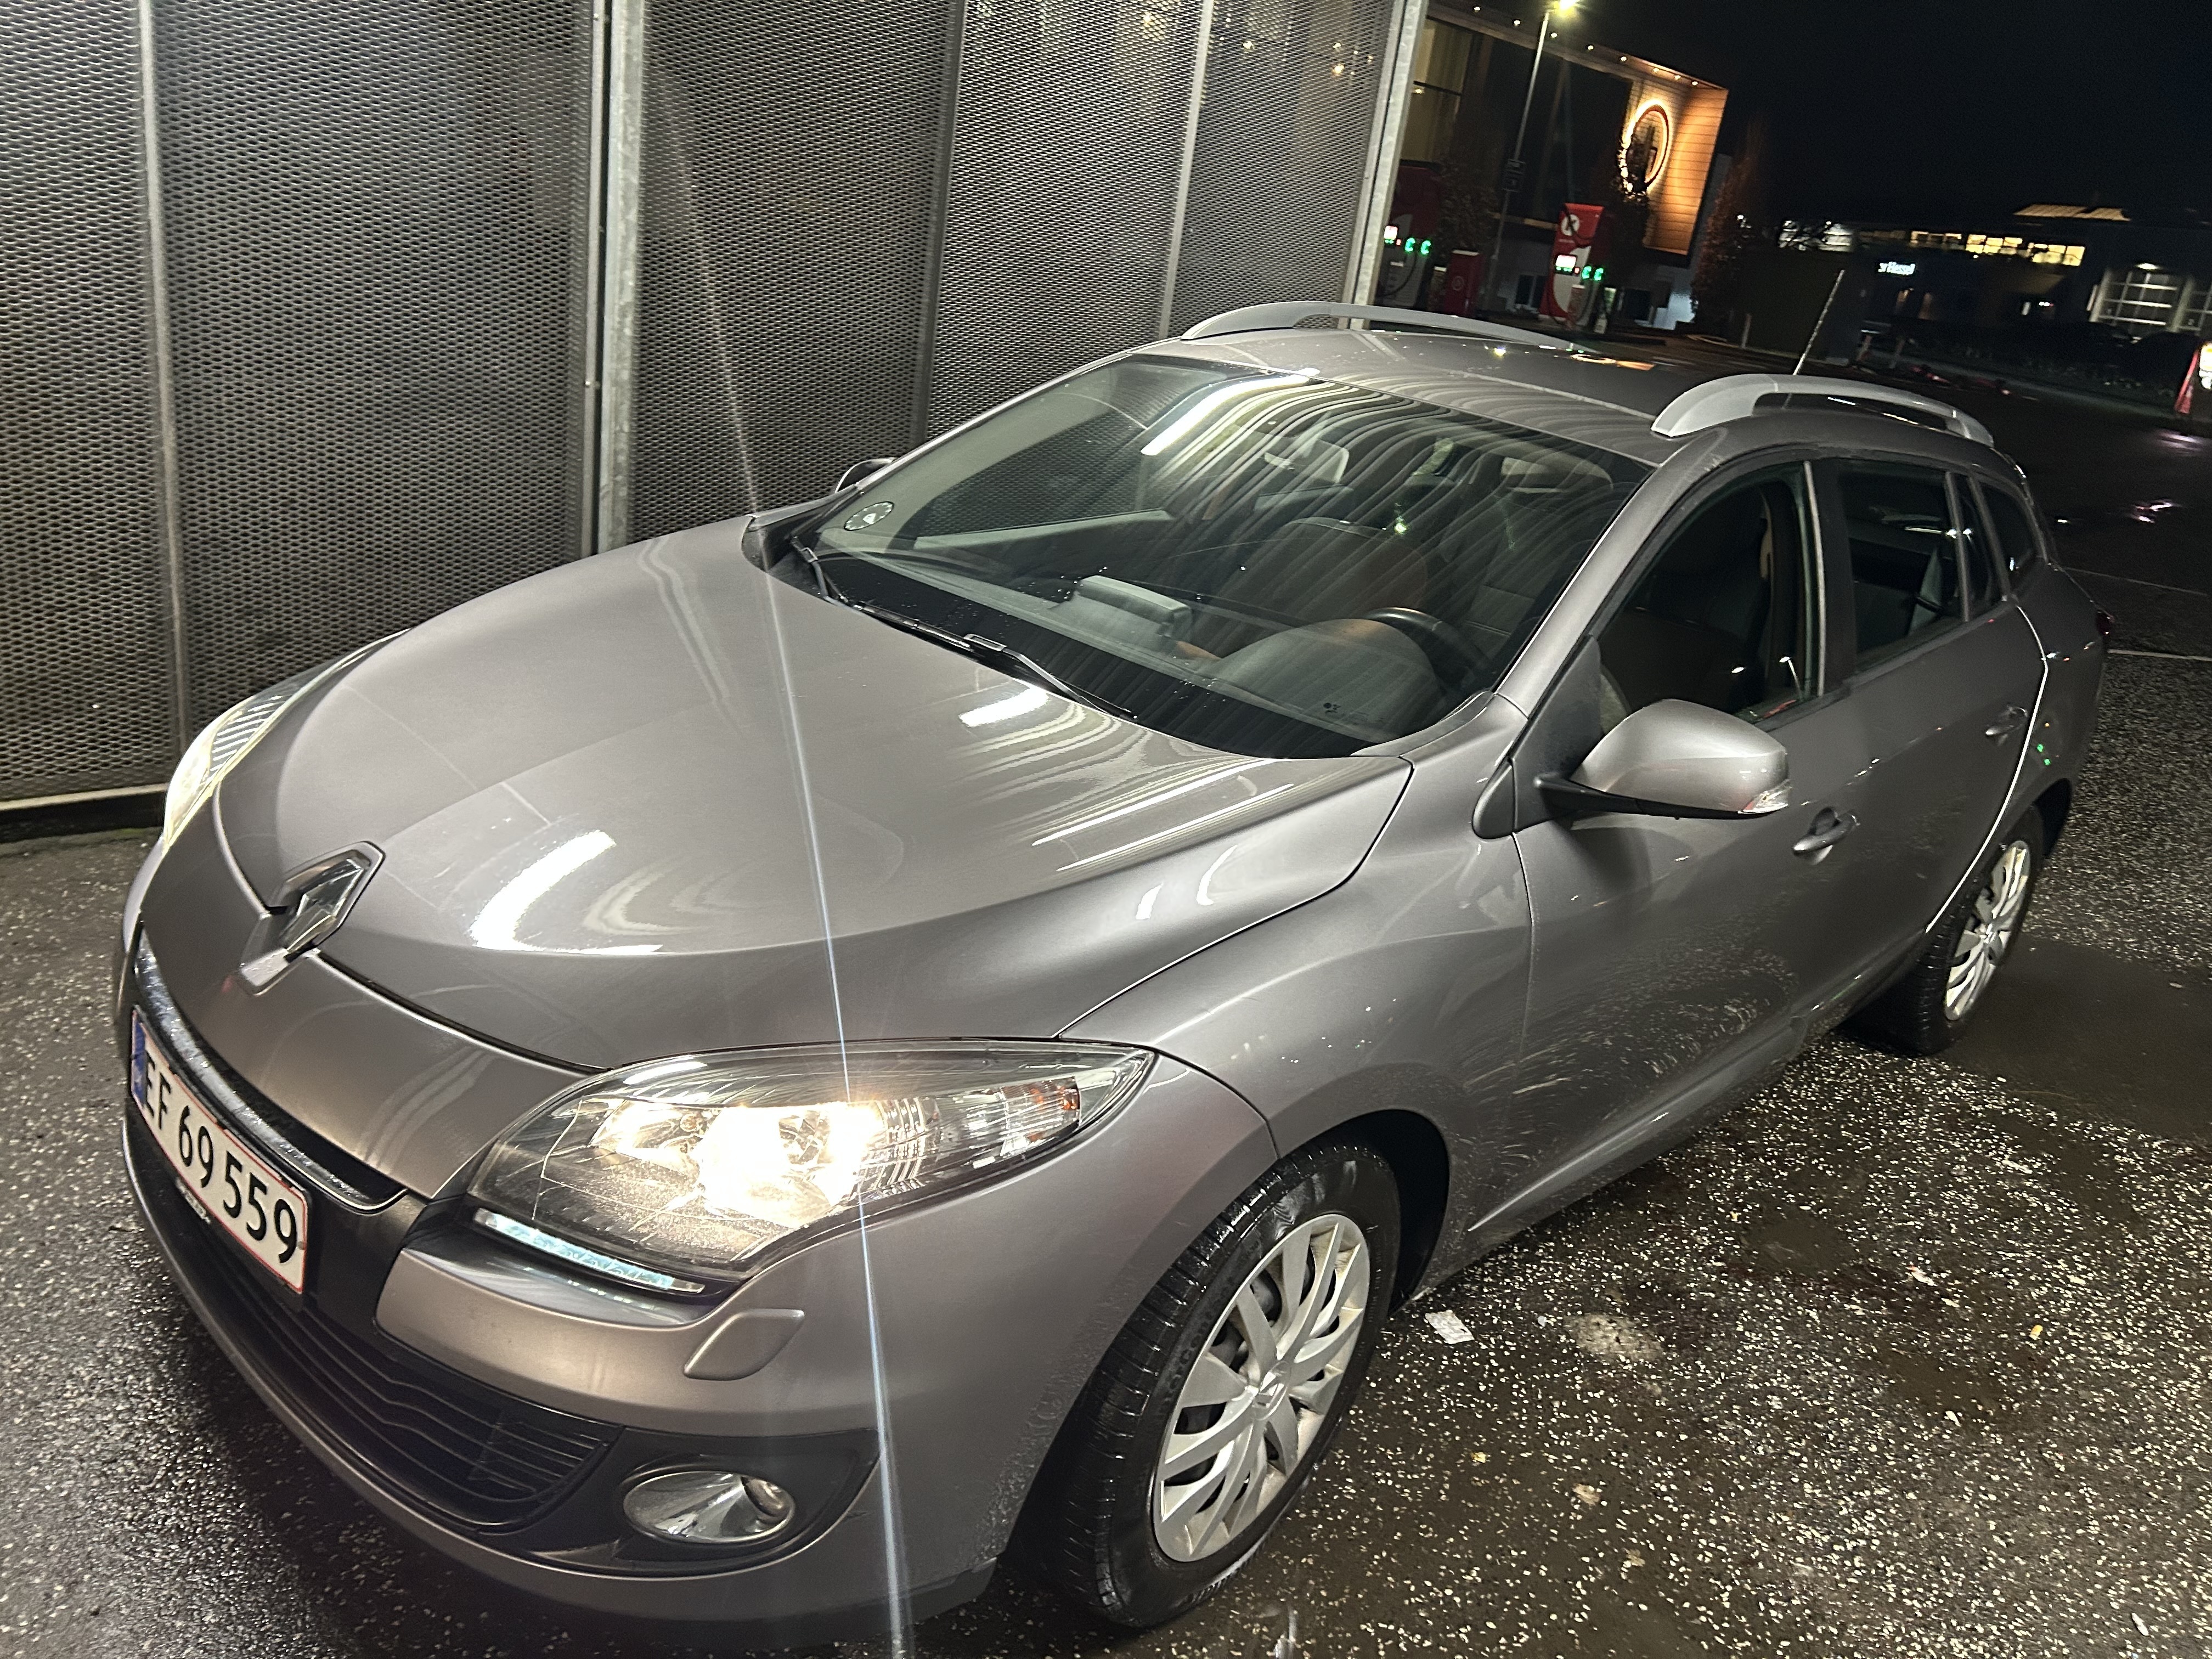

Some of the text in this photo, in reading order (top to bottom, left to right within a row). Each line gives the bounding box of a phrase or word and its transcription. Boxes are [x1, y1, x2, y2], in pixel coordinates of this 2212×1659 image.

[145, 1052, 172, 1130] EF
[179, 1105, 214, 1188] 69
[223, 1151, 297, 1263] 559
